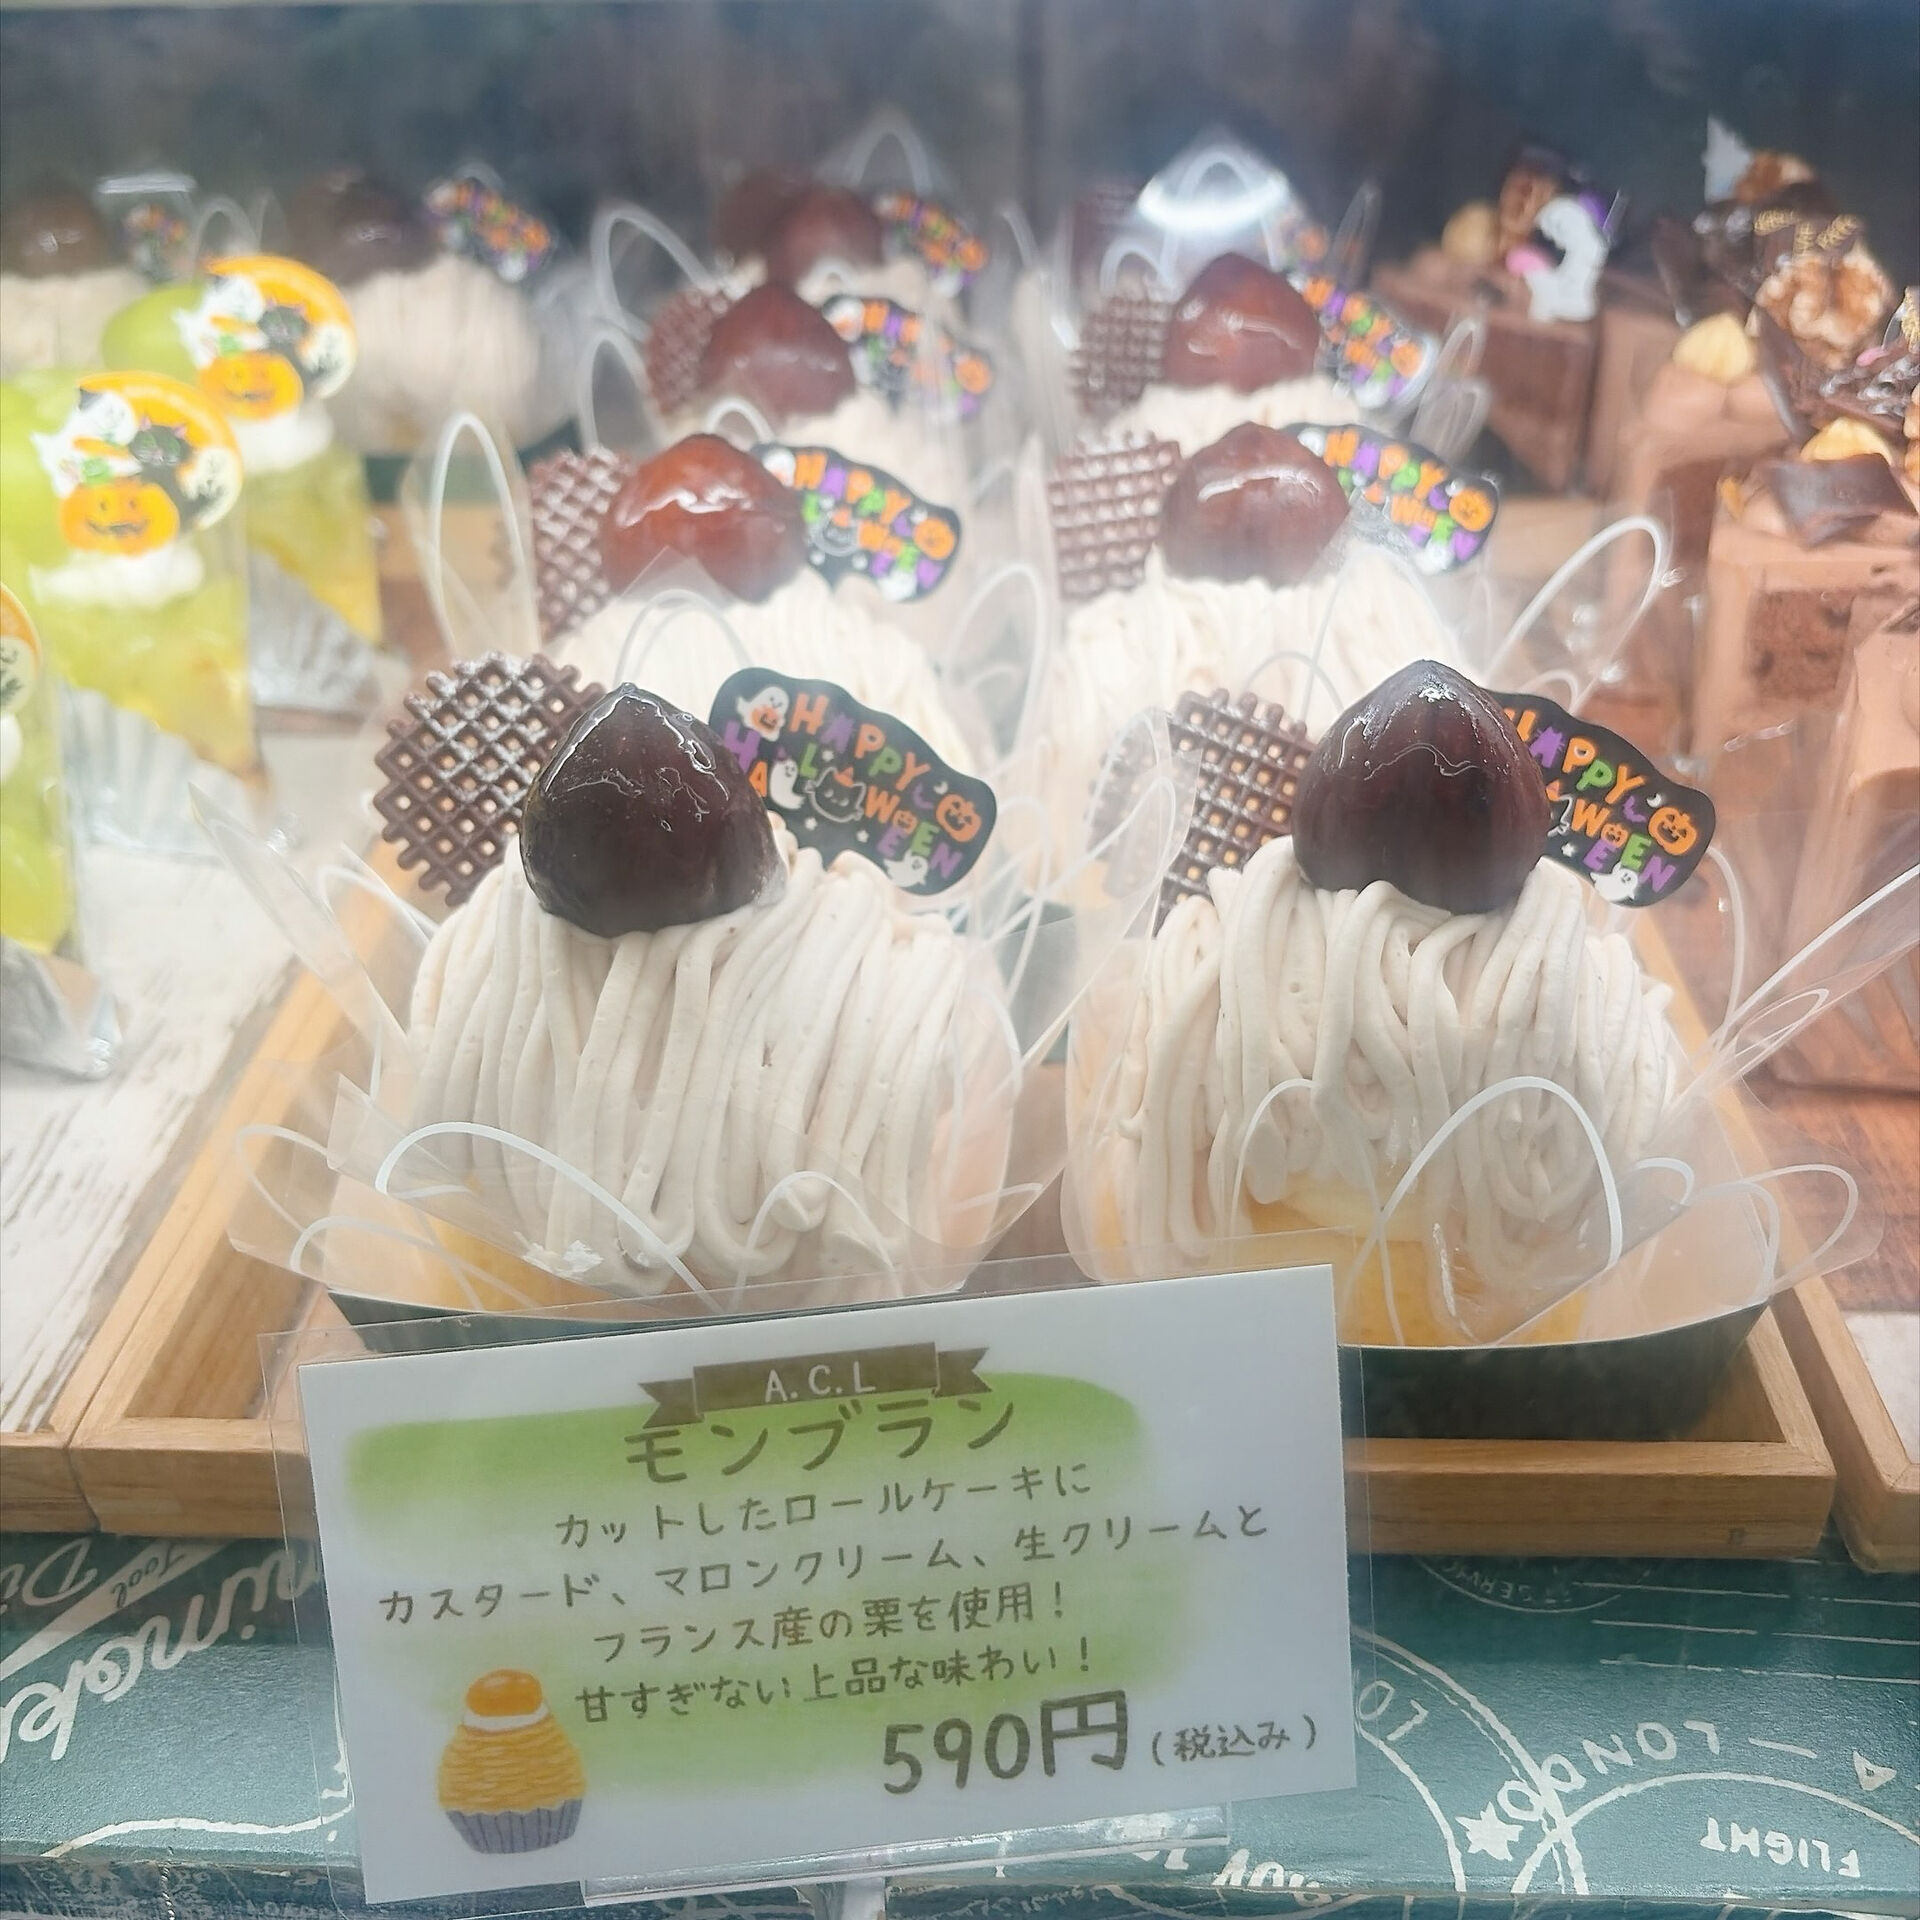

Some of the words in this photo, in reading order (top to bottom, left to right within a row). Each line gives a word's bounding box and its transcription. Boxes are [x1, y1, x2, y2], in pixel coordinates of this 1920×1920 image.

[790, 693, 931, 791] HAPPY
[764, 1361, 876, 1403] A.C.L
[624, 1398, 1014, 1484] モンブラン
[555, 1463, 1091, 1549] カットしたロールケーキに
[883, 1690, 1128, 1795] 590円
[1700, 1816, 1861, 1879] FLIGHT
